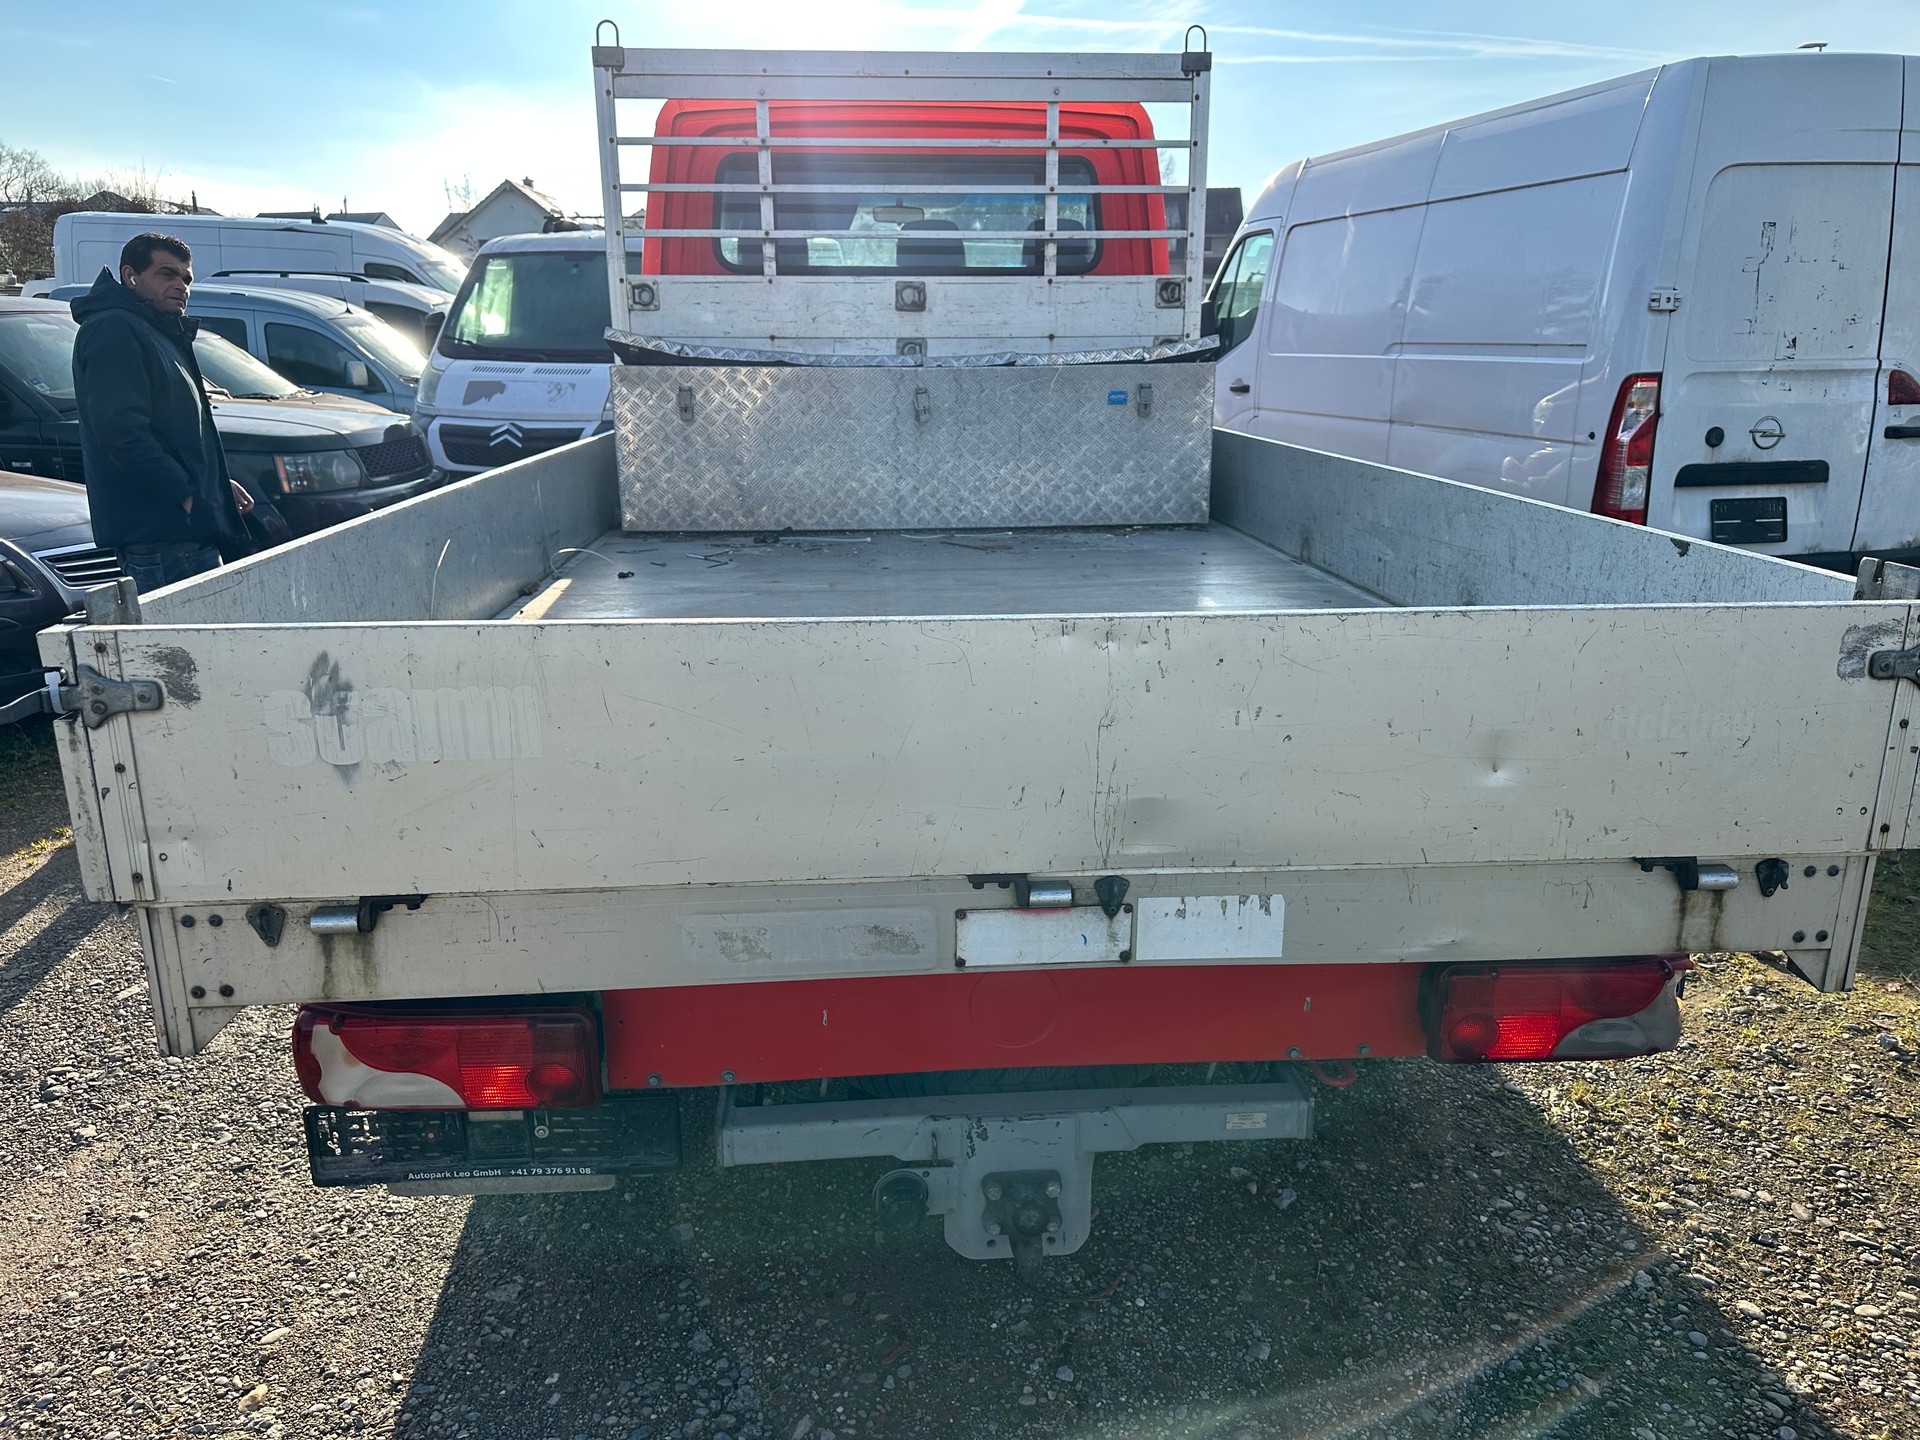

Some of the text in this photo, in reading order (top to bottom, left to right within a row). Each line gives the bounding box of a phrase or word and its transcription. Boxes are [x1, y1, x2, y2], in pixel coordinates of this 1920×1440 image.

[407, 1166, 592, 1181] Autopark Leo GmbH +41 79 376 91 08
